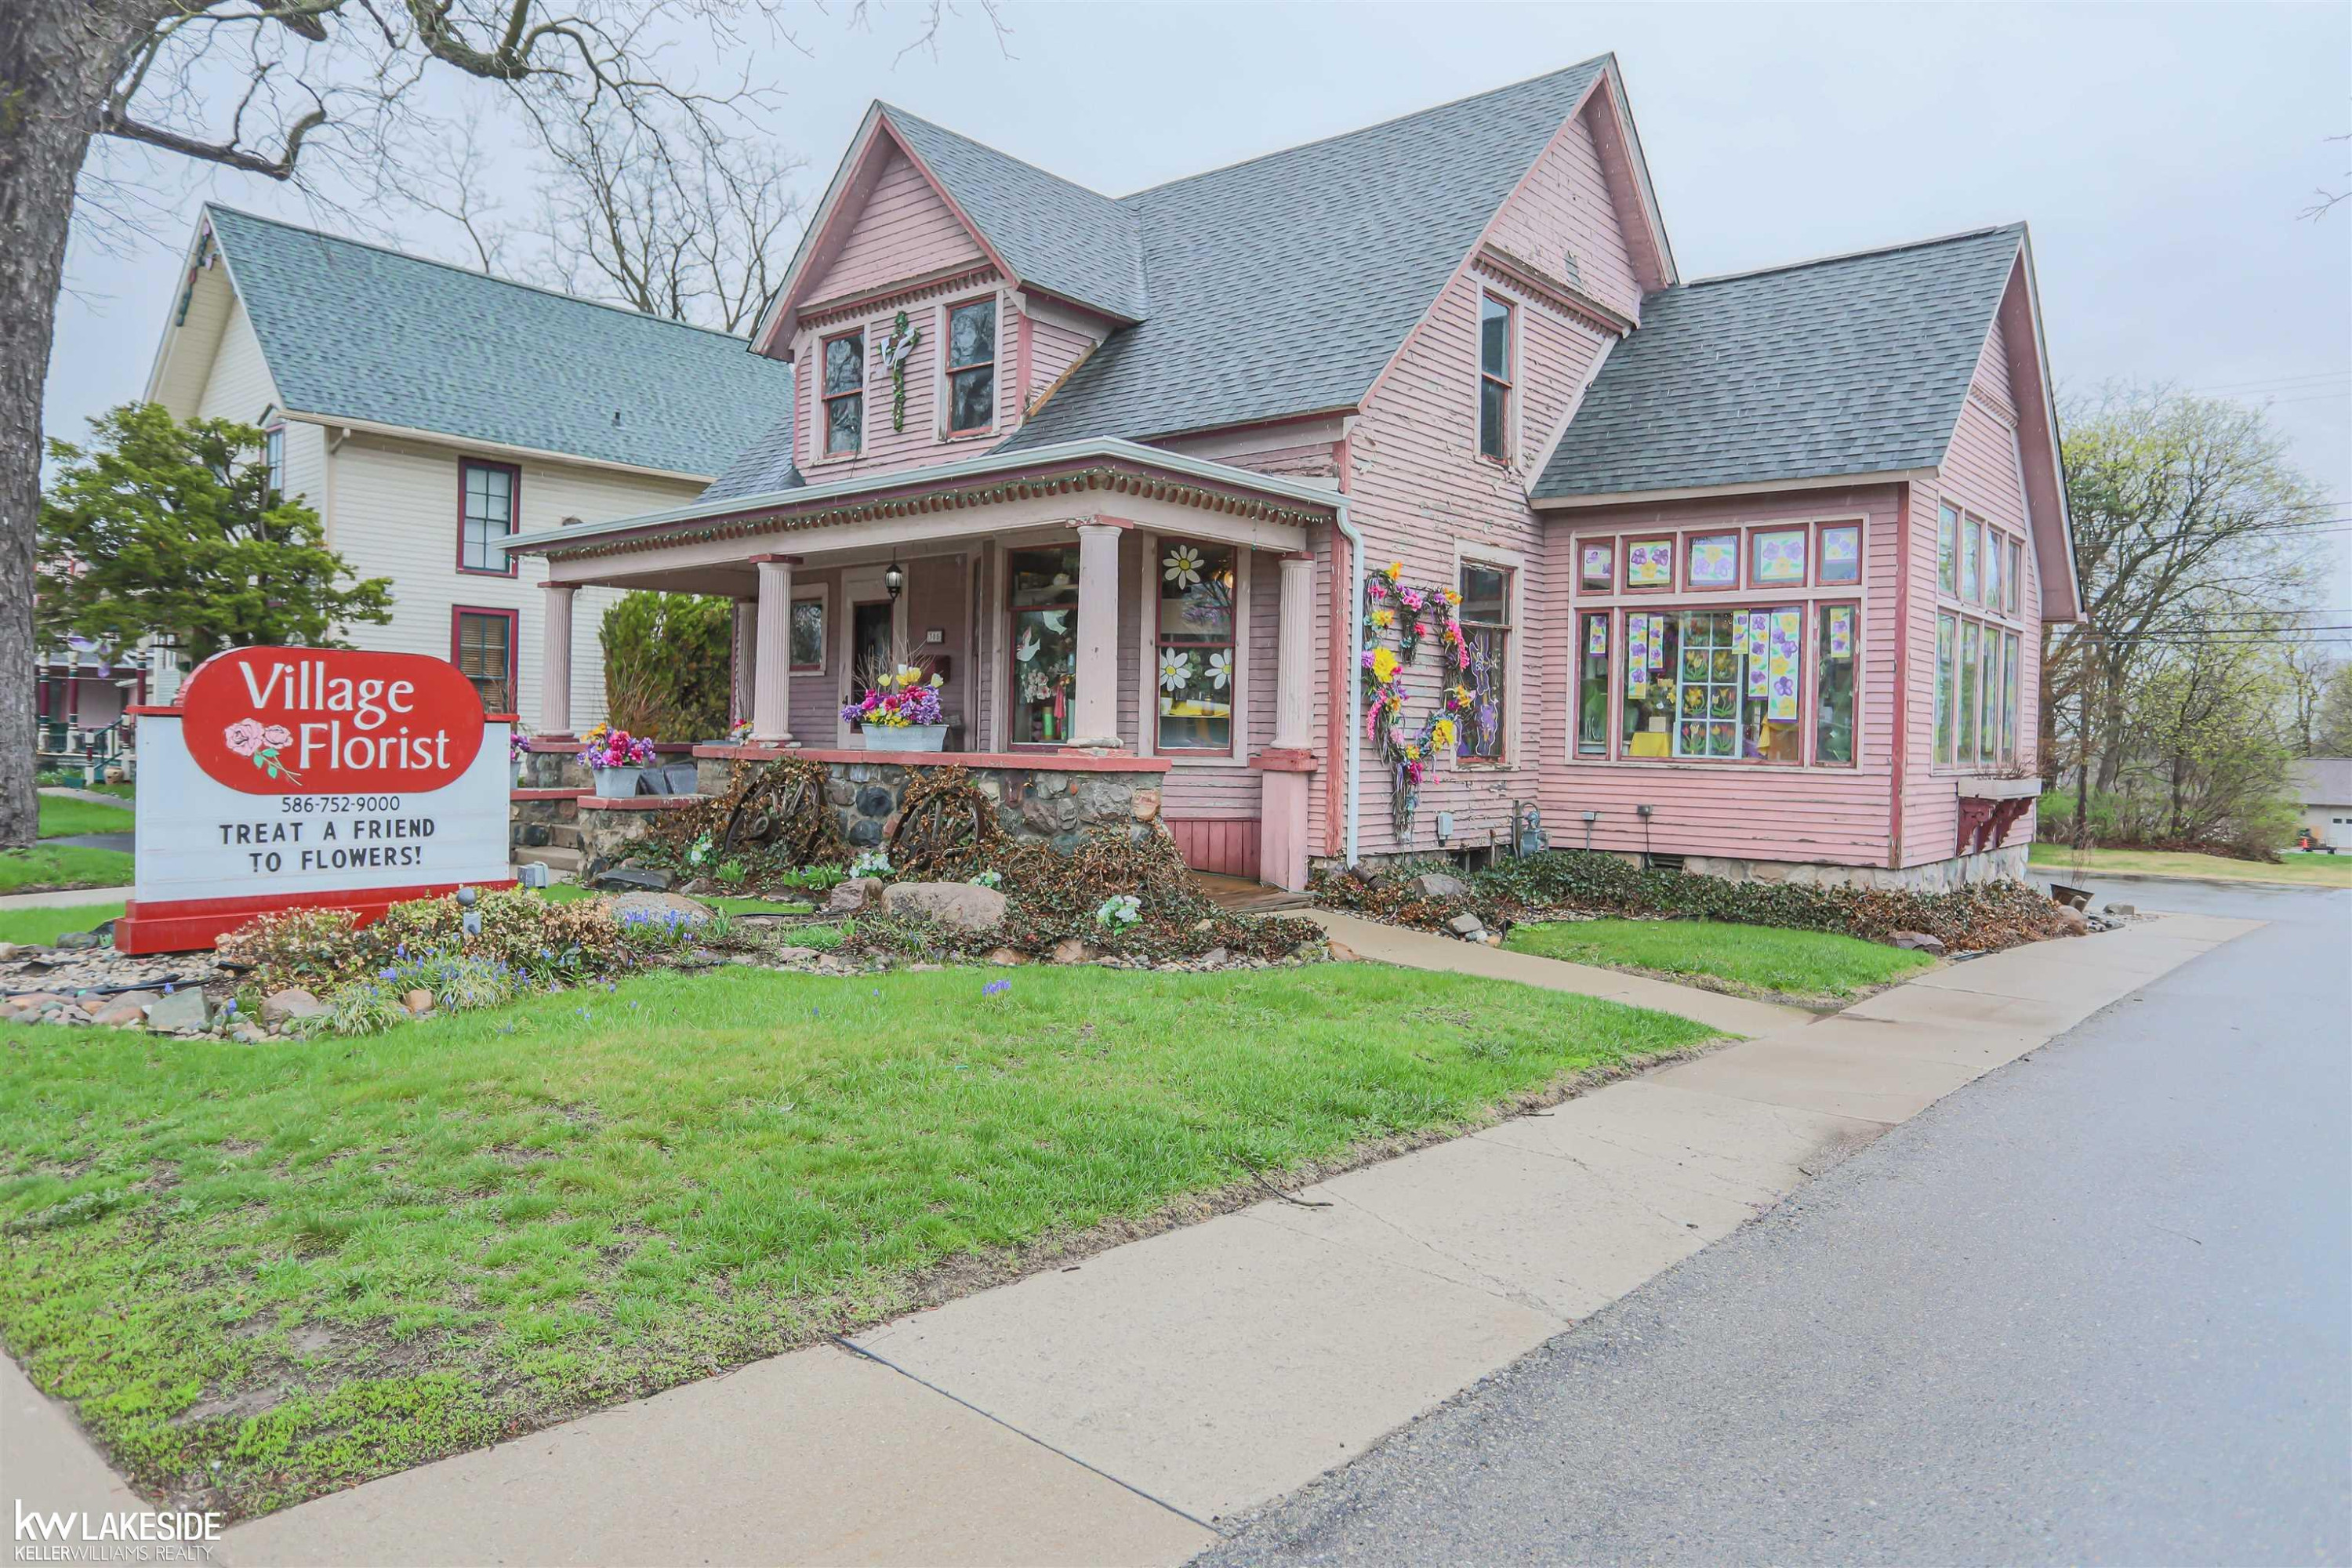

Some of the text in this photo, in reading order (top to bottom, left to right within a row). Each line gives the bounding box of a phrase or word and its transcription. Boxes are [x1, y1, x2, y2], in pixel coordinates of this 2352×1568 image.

[238, 660, 415, 731] Village
[299, 720, 452, 770] Florist
[281, 796, 401, 813] 586-752-9000
[219, 818, 435, 845] TREAT A FRIEND
[249, 846, 423, 873] TO FLOWERS!
